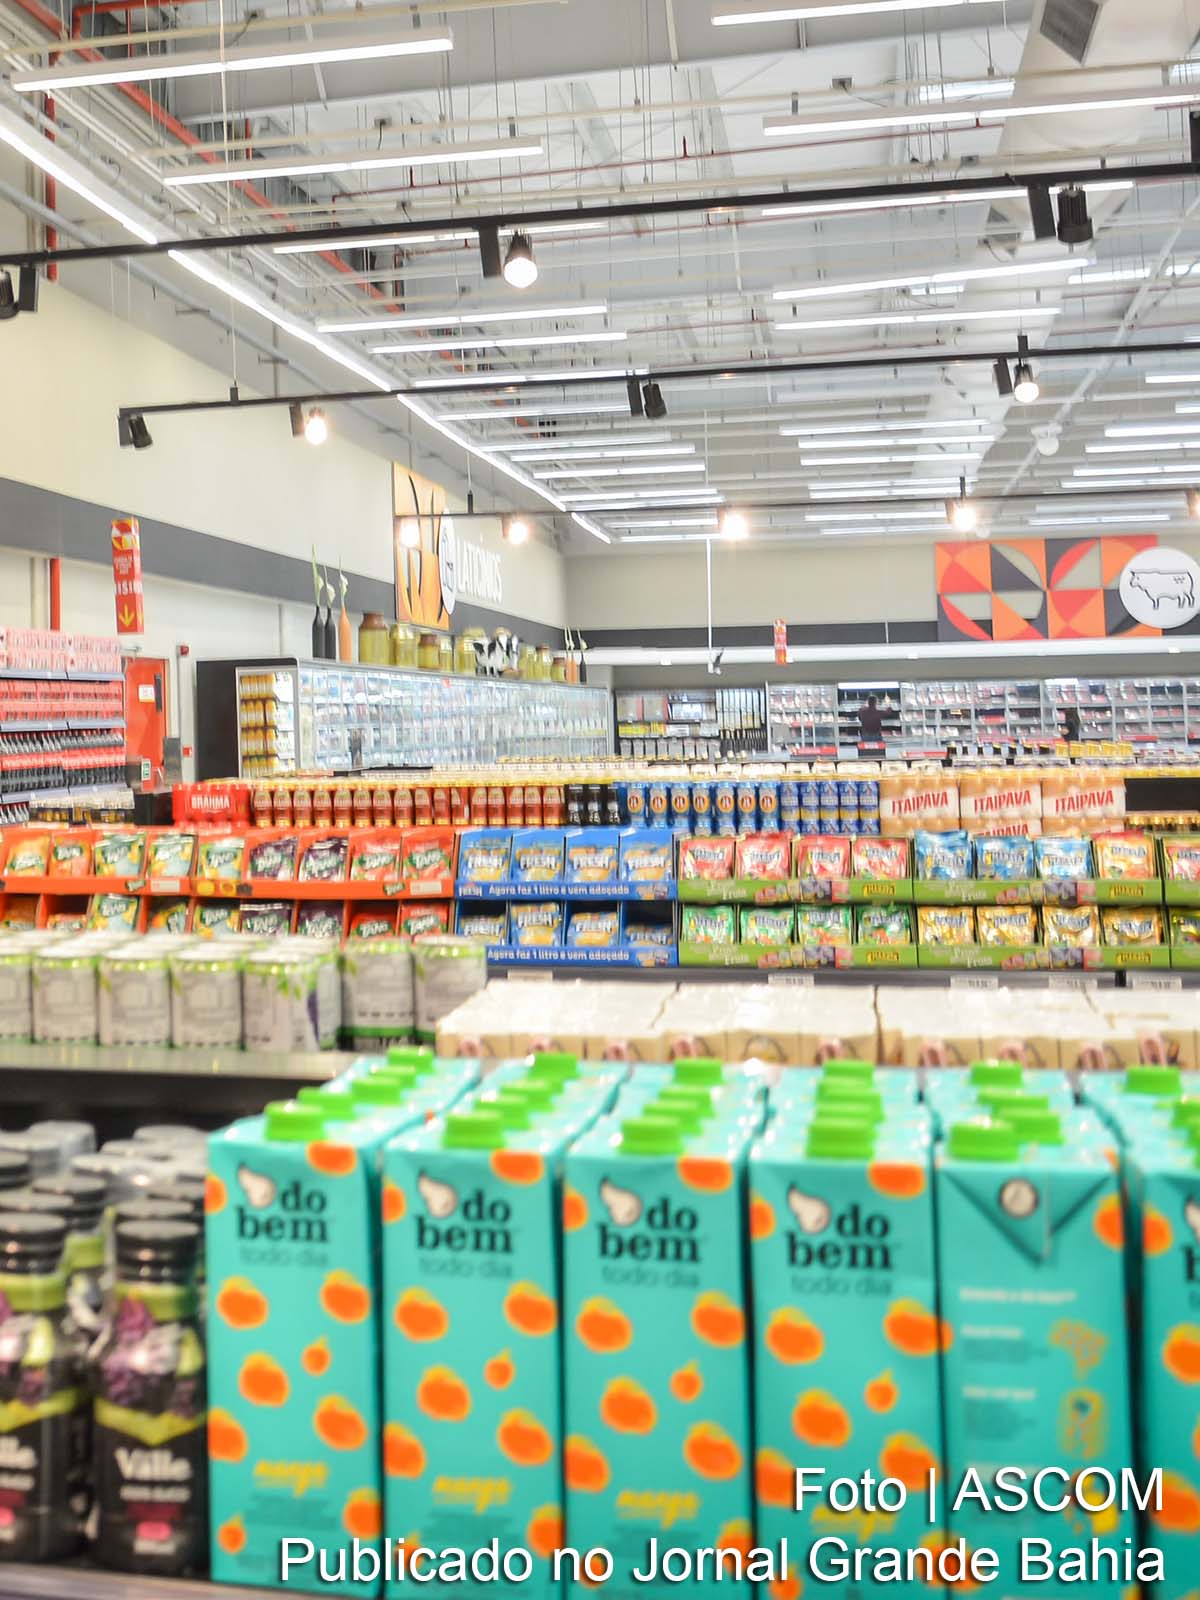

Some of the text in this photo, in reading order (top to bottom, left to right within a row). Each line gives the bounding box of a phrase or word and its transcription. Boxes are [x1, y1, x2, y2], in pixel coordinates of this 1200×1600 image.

[191, 795, 230, 809] BRAHMA
[892, 791, 948, 814] ITAIPAVA
[974, 790, 1031, 813] ITAIPAVA
[1056, 790, 1114, 813] ITAIPAVA
[280, 1180, 327, 1214] do
[462, 1189, 511, 1223] do
[646, 1195, 698, 1233] do
[236, 1205, 329, 1243] bem
[416, 1214, 514, 1254] bem
[836, 1204, 890, 1239] do
[598, 1222, 701, 1263] bem
[787, 1230, 893, 1270] bem
